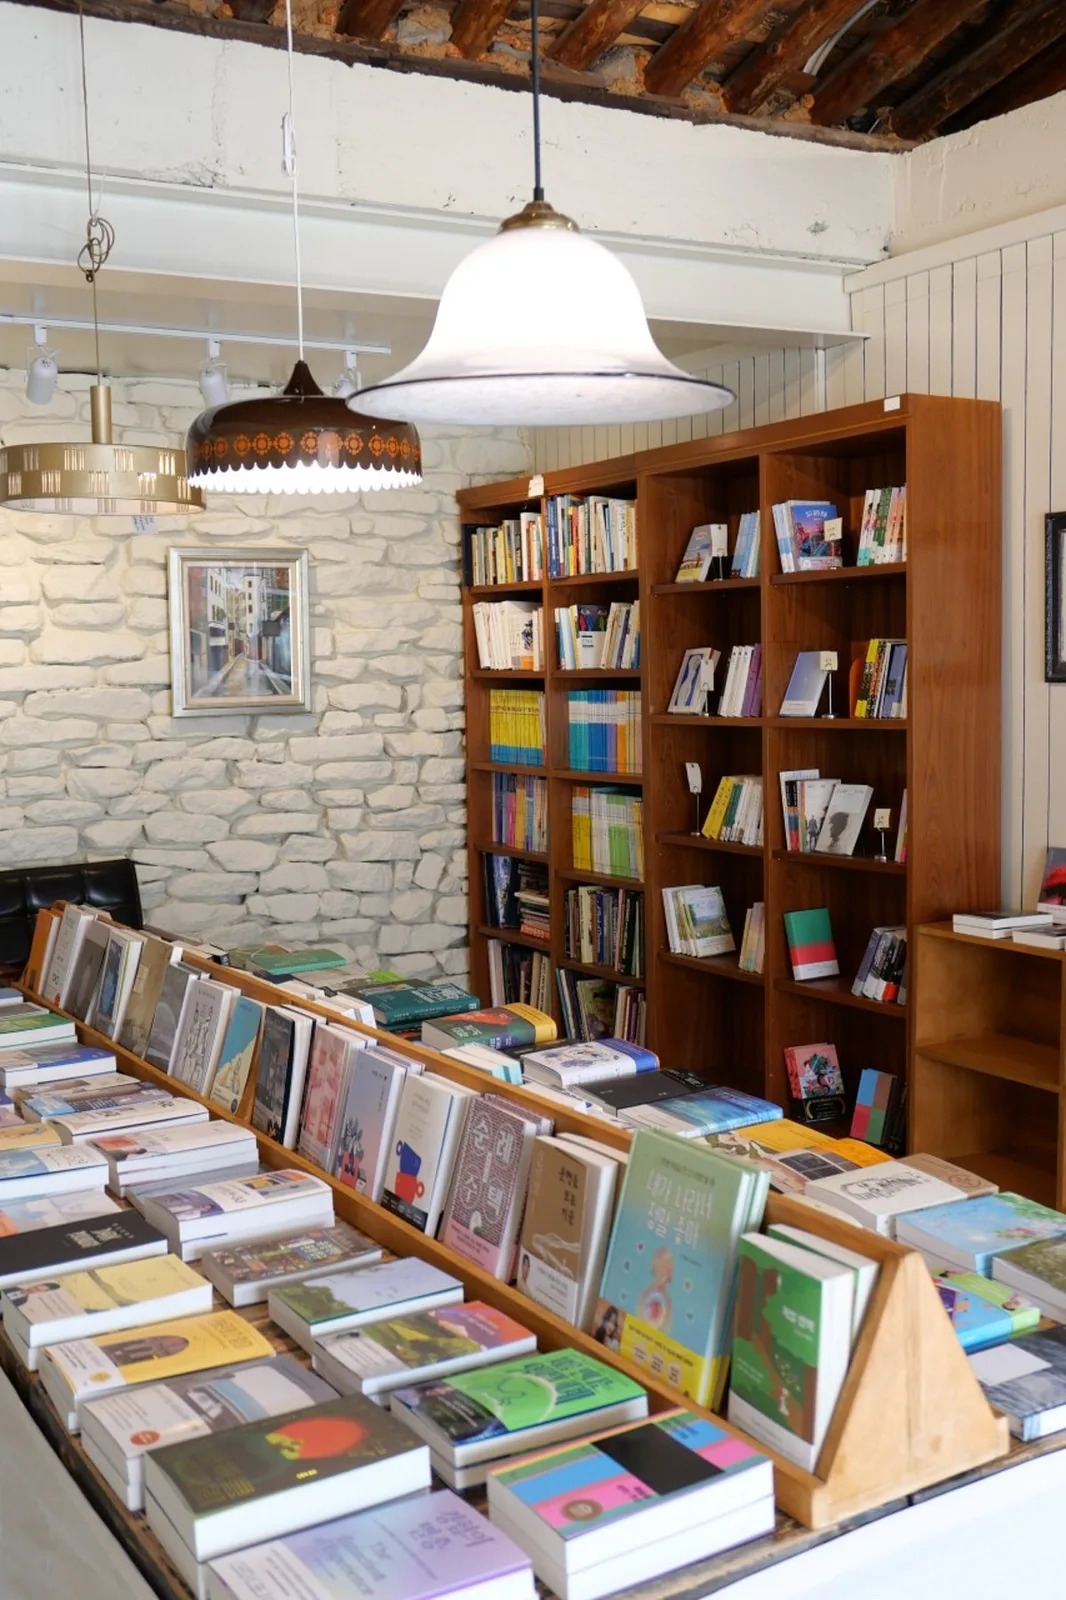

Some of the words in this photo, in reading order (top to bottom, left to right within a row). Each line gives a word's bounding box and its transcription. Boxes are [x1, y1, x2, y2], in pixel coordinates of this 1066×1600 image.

[473, 1119, 514, 1164] 순례
[464, 1171, 504, 1217] 주택
[674, 1184, 713, 1221] 나라서
[646, 1200, 671, 1239] 정말
[673, 1215, 701, 1252] 좋아
